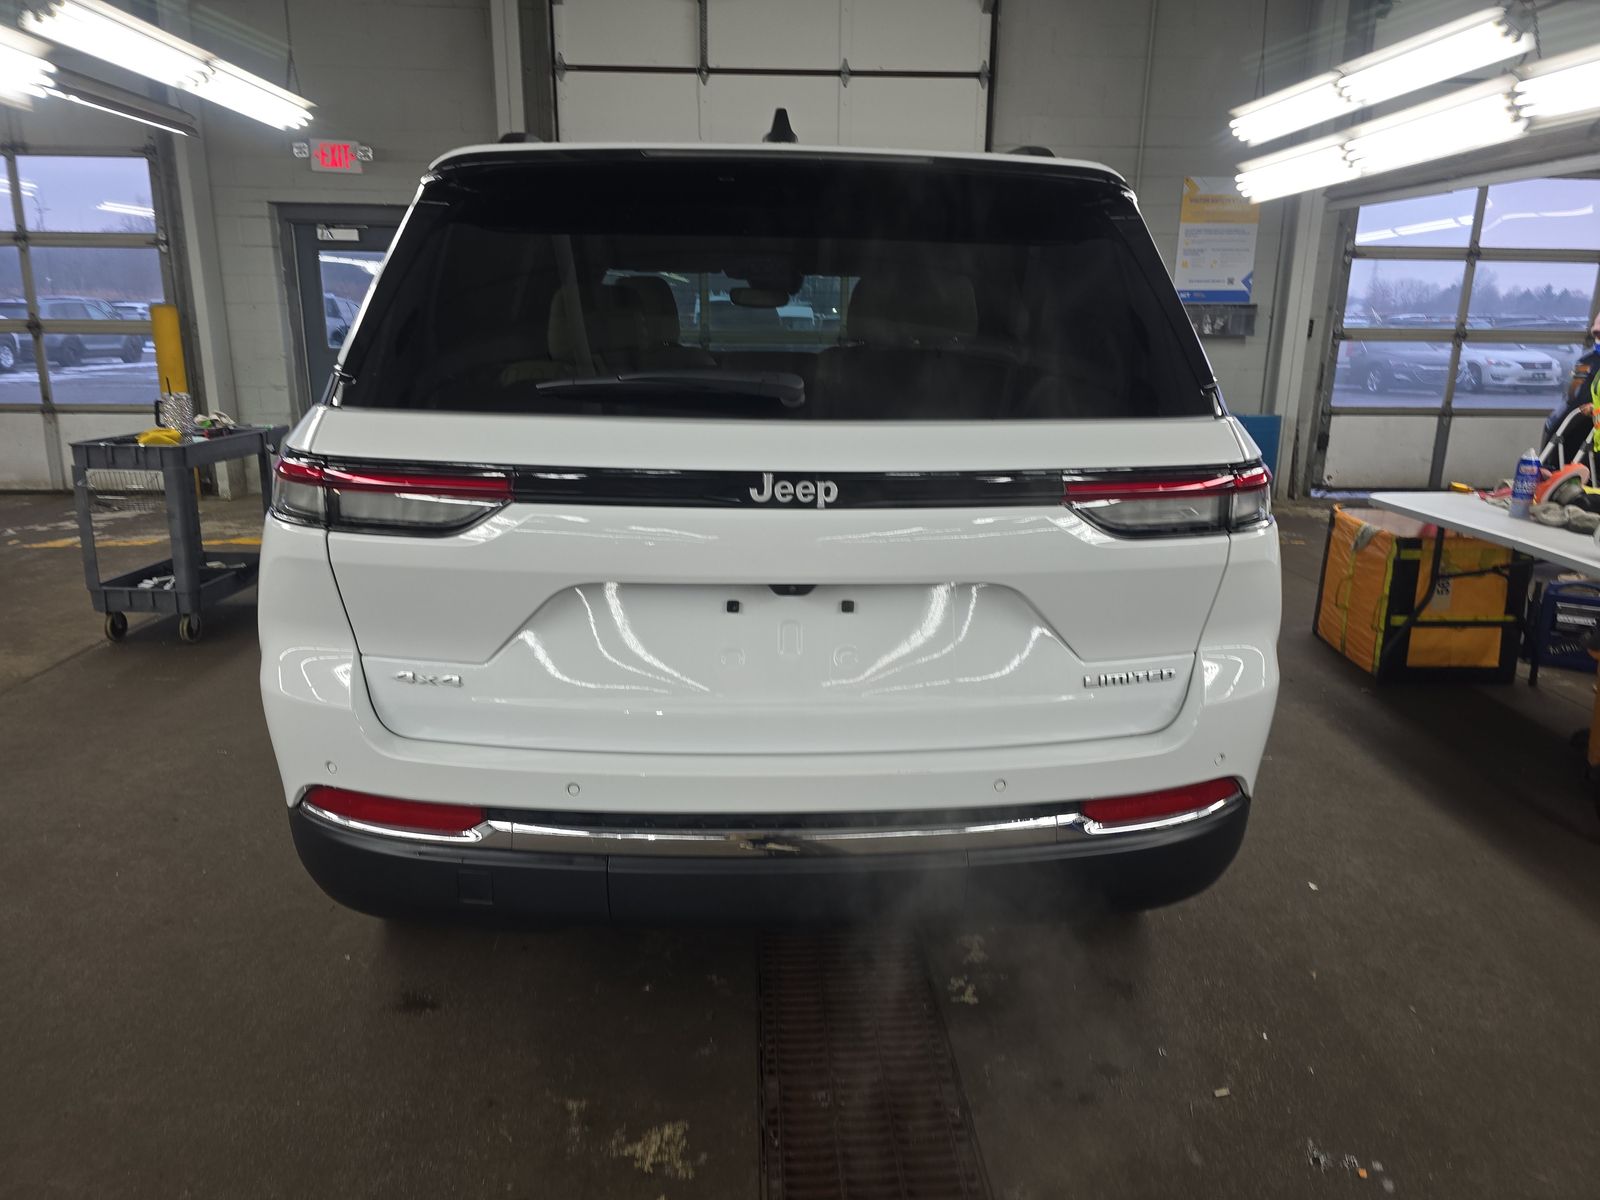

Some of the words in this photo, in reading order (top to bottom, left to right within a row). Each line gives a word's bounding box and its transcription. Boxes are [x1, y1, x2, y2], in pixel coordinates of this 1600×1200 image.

[319, 143, 351, 169] EXIT
[749, 472, 838, 509] Jeep
[1083, 668, 1176, 689] LIMITED
